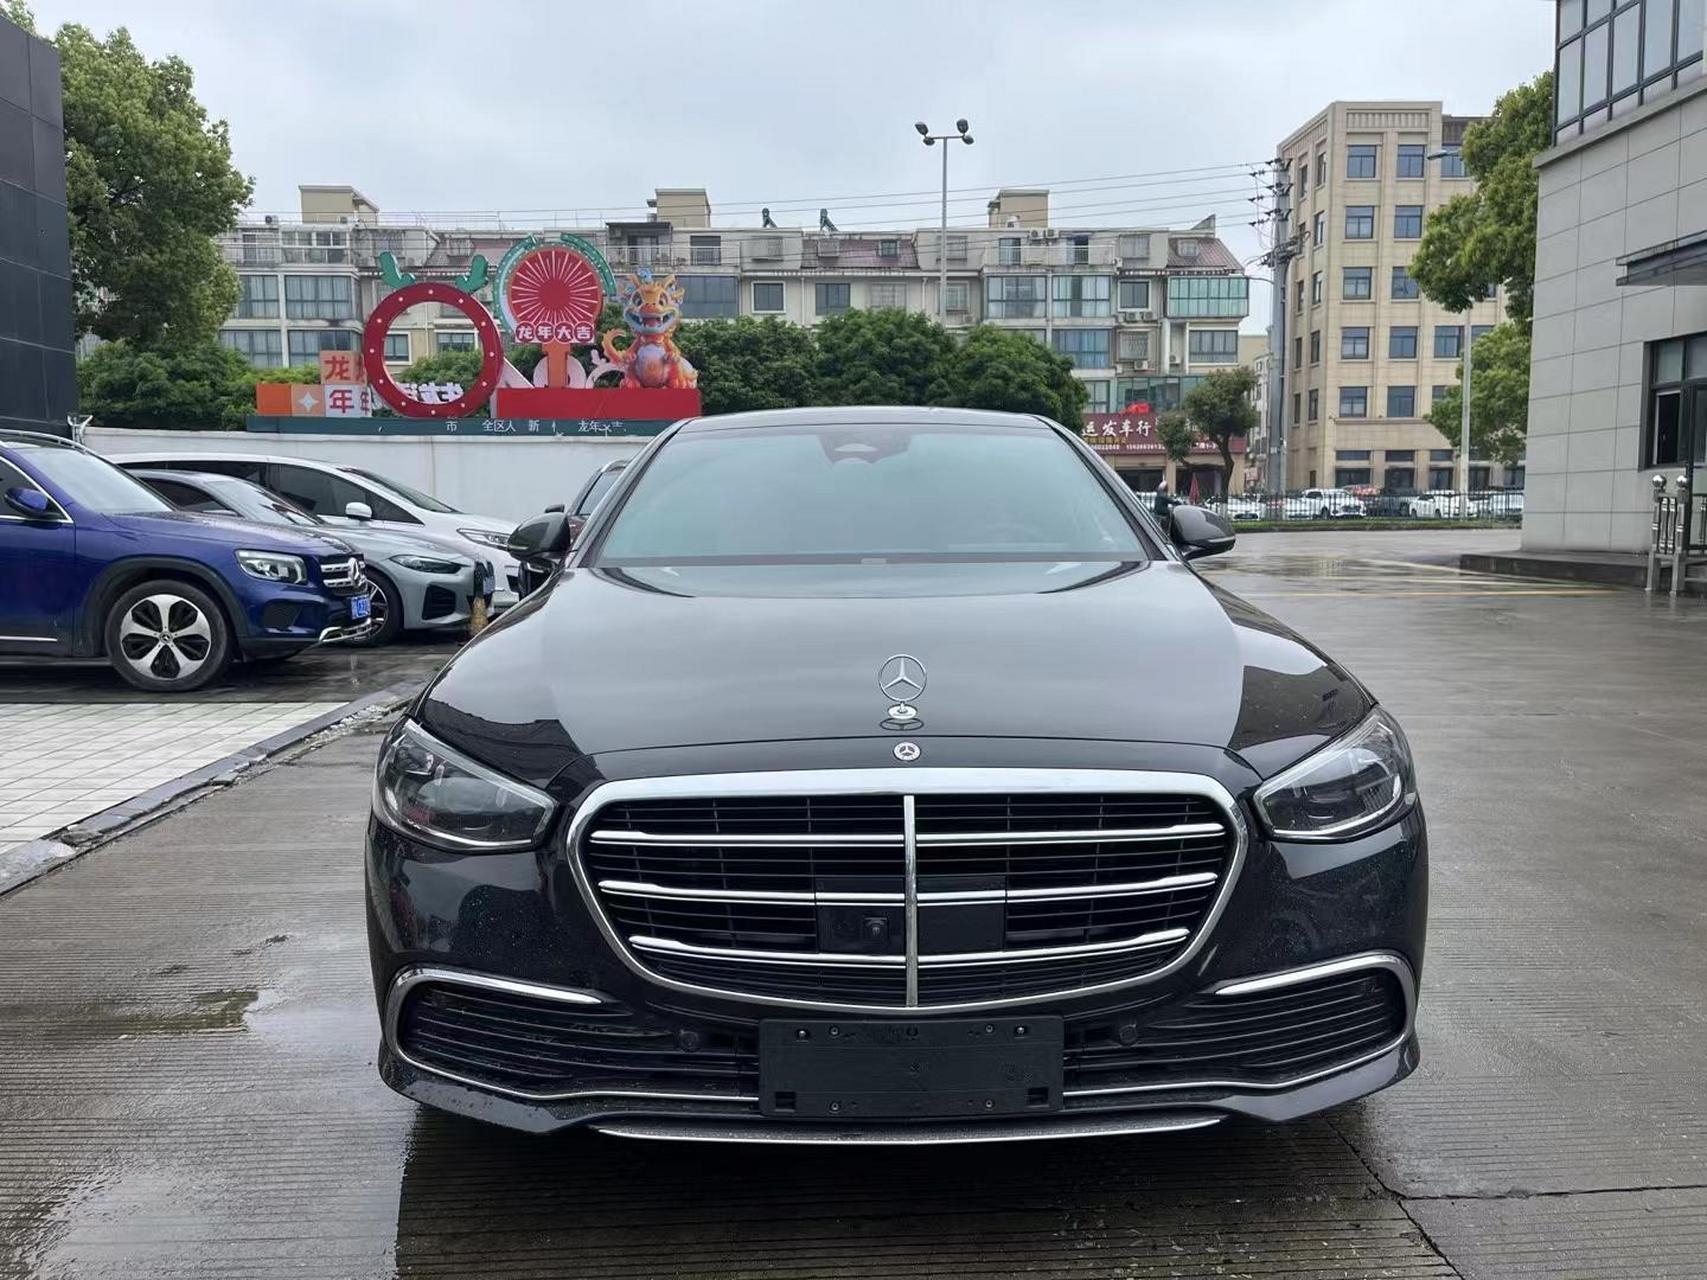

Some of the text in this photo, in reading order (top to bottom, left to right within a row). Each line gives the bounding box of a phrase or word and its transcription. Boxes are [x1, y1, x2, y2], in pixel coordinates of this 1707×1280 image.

[518, 325, 591, 339] 龙年大吉
[324, 356, 350, 380] 龙
[329, 389, 354, 414] 年
